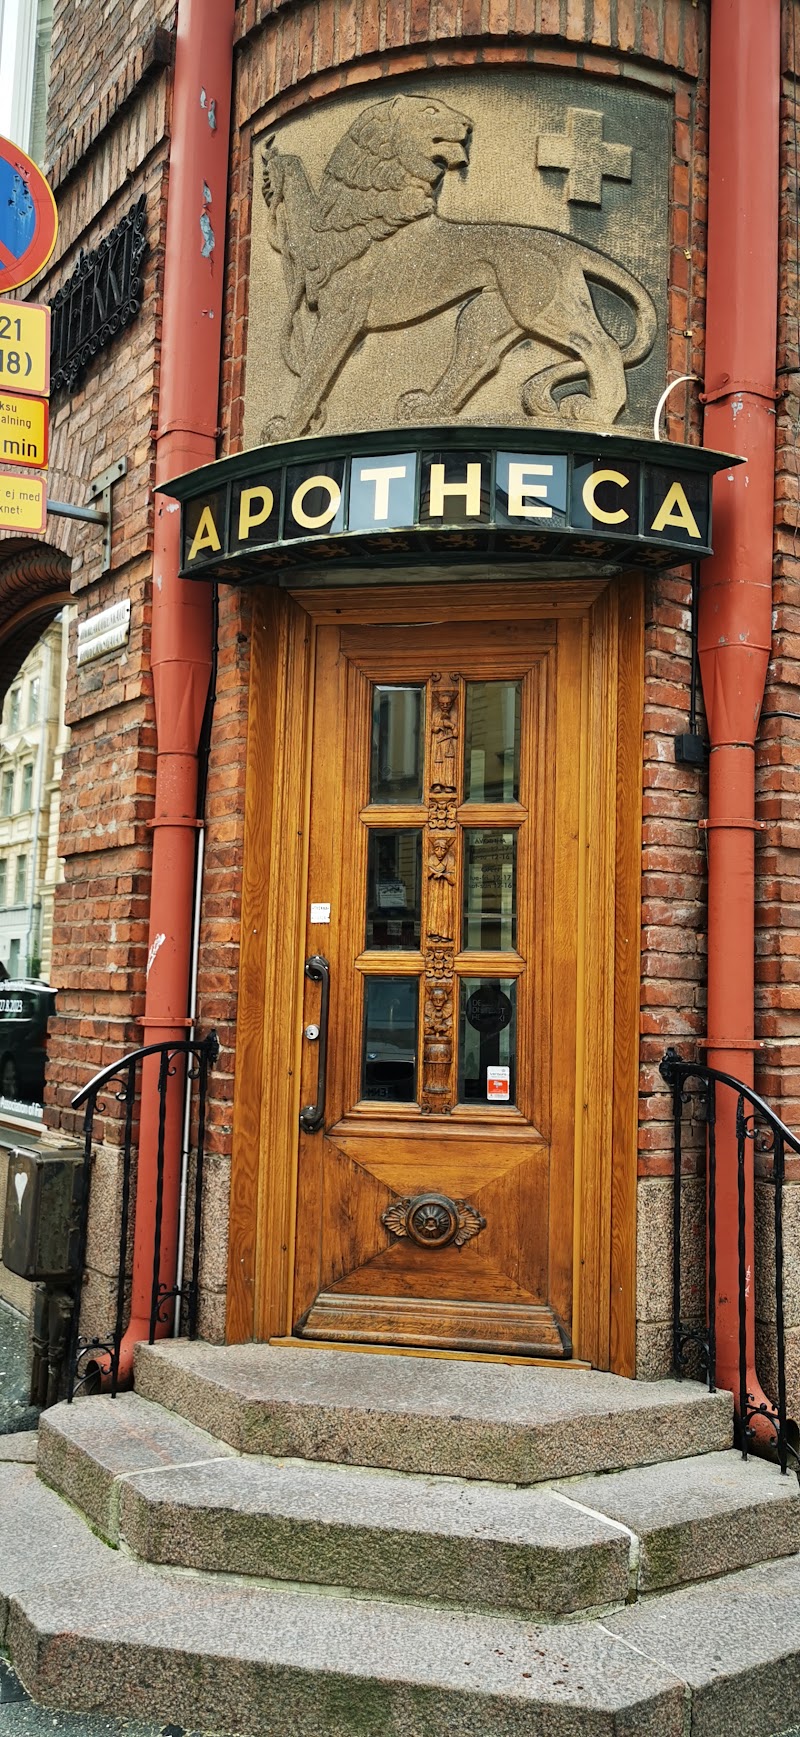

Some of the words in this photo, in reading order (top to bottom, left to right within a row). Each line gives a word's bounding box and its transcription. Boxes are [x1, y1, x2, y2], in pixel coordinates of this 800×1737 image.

[1, 415, 32, 429] alning
[3, 438, 37, 458] min
[5, 489, 15, 500] ej
[19, 492, 41, 502] med
[187, 461, 703, 561] APOTHECA
